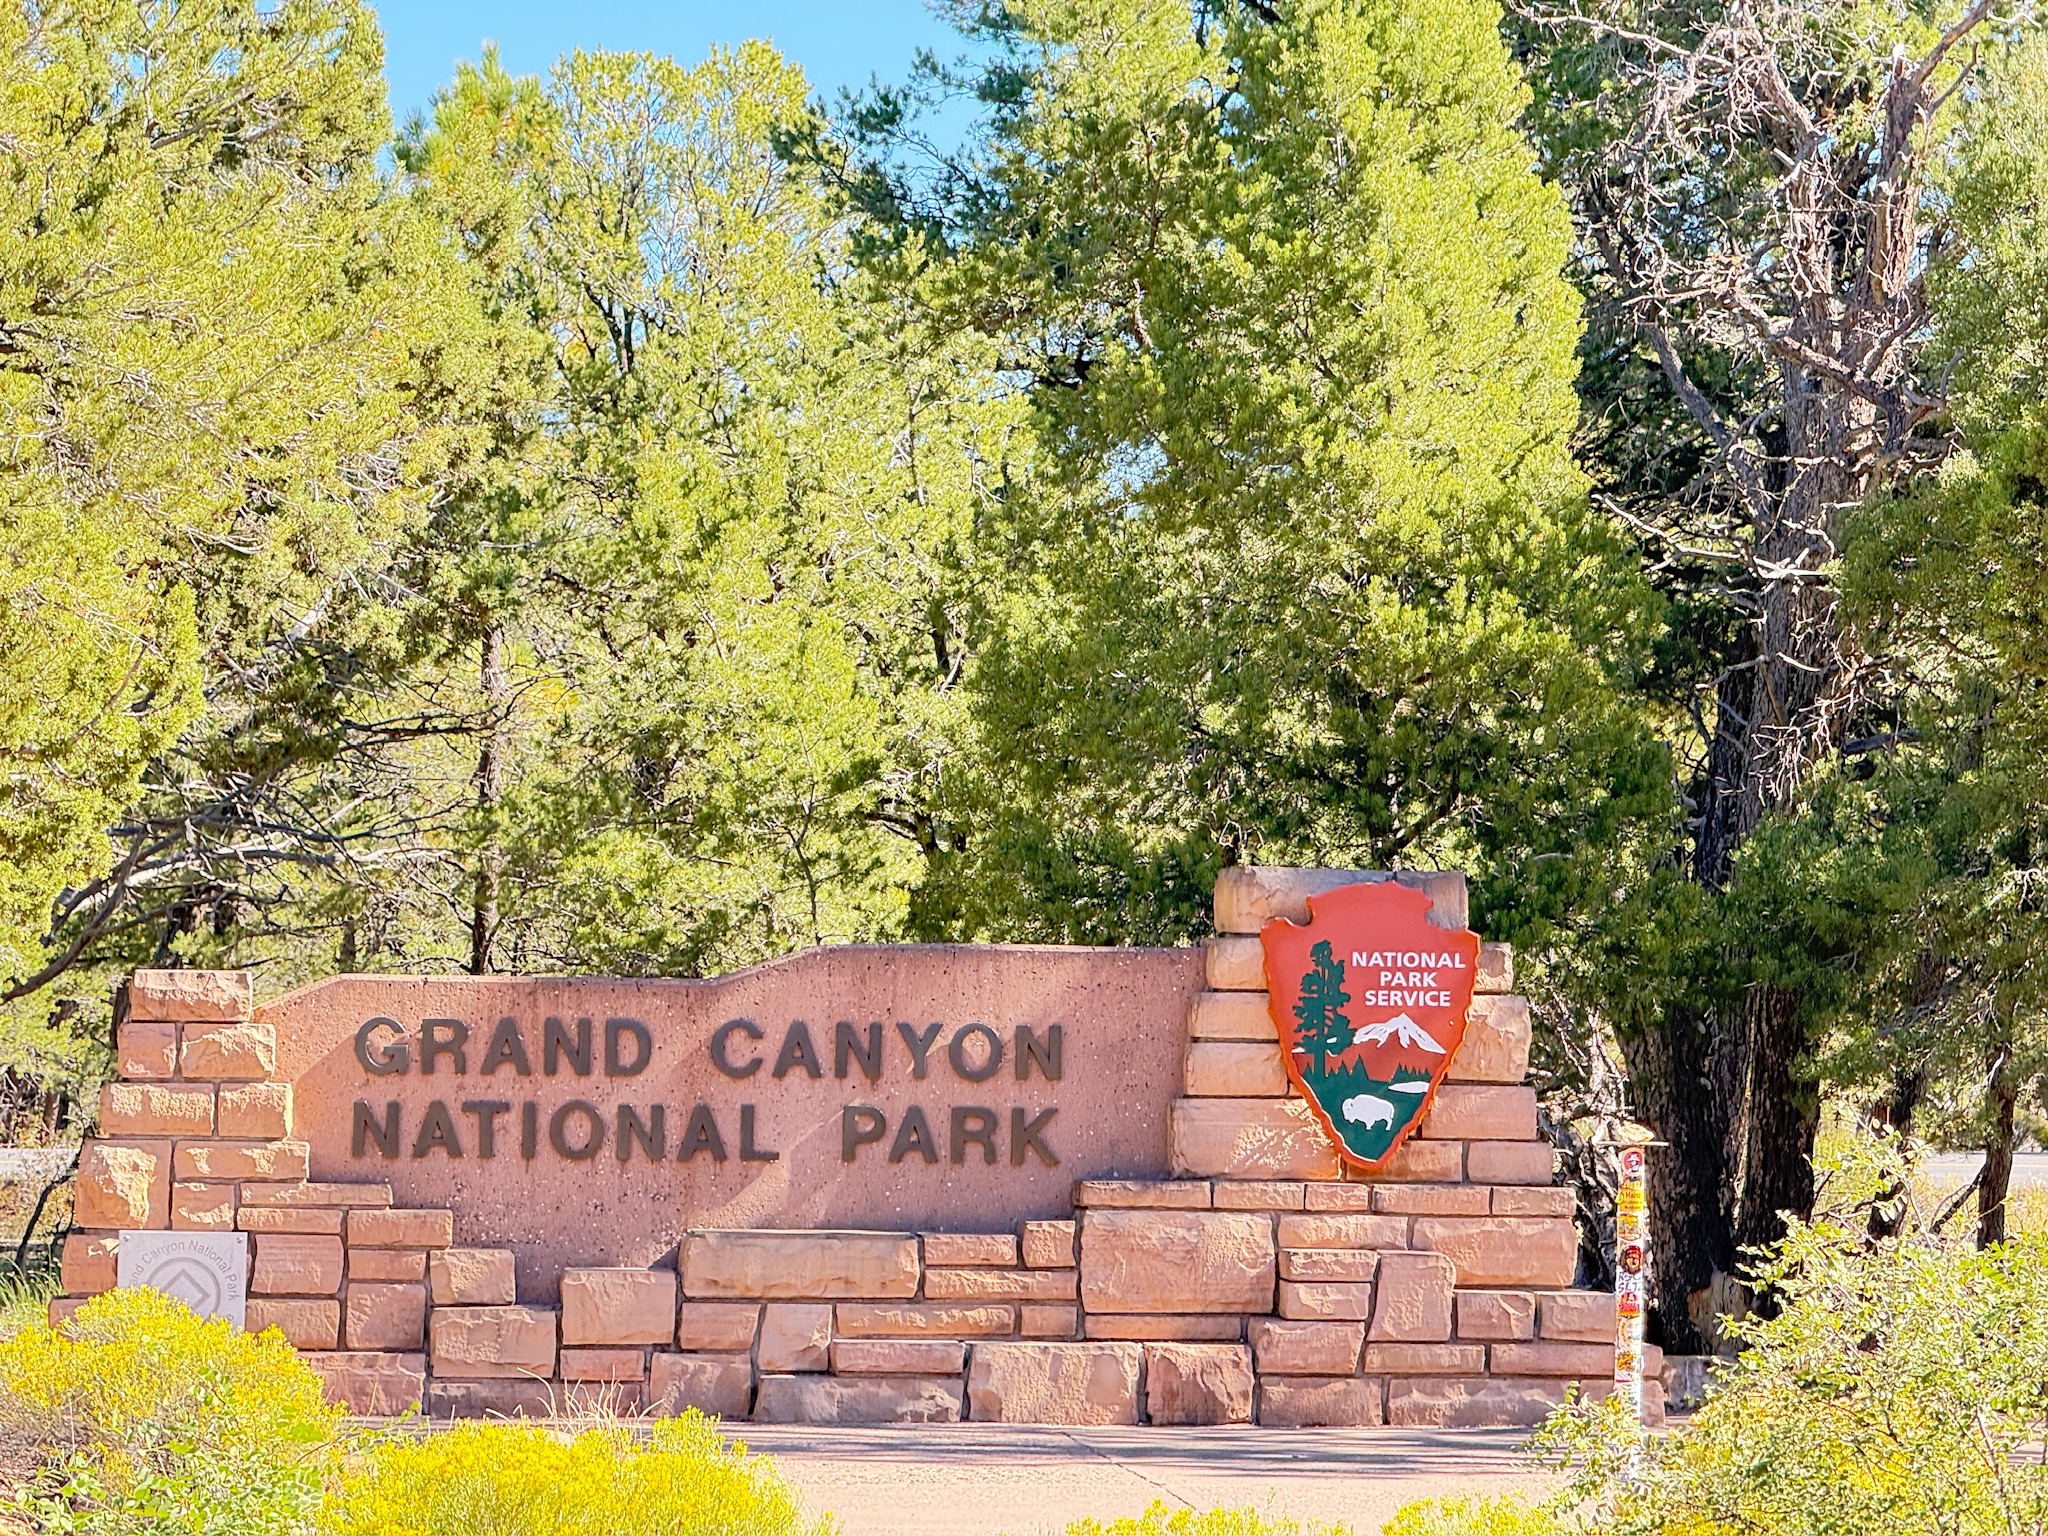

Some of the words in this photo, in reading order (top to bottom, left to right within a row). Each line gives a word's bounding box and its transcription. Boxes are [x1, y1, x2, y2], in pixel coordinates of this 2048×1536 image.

[1352, 951, 1466, 968] NATIONAL
[1380, 971, 1437, 987] PARK
[1364, 990, 1451, 1007] SERVICE
[353, 1016, 653, 1079] GRAND
[710, 1018, 1063, 1083] CANYON
[352, 1099, 780, 1163] NATIONAL
[841, 1104, 1060, 1167] PARK
[129, 1264, 144, 1288] and
[141, 1240, 186, 1264] Canyon
[188, 1239, 232, 1274] National
[225, 1273, 240, 1302] Park
